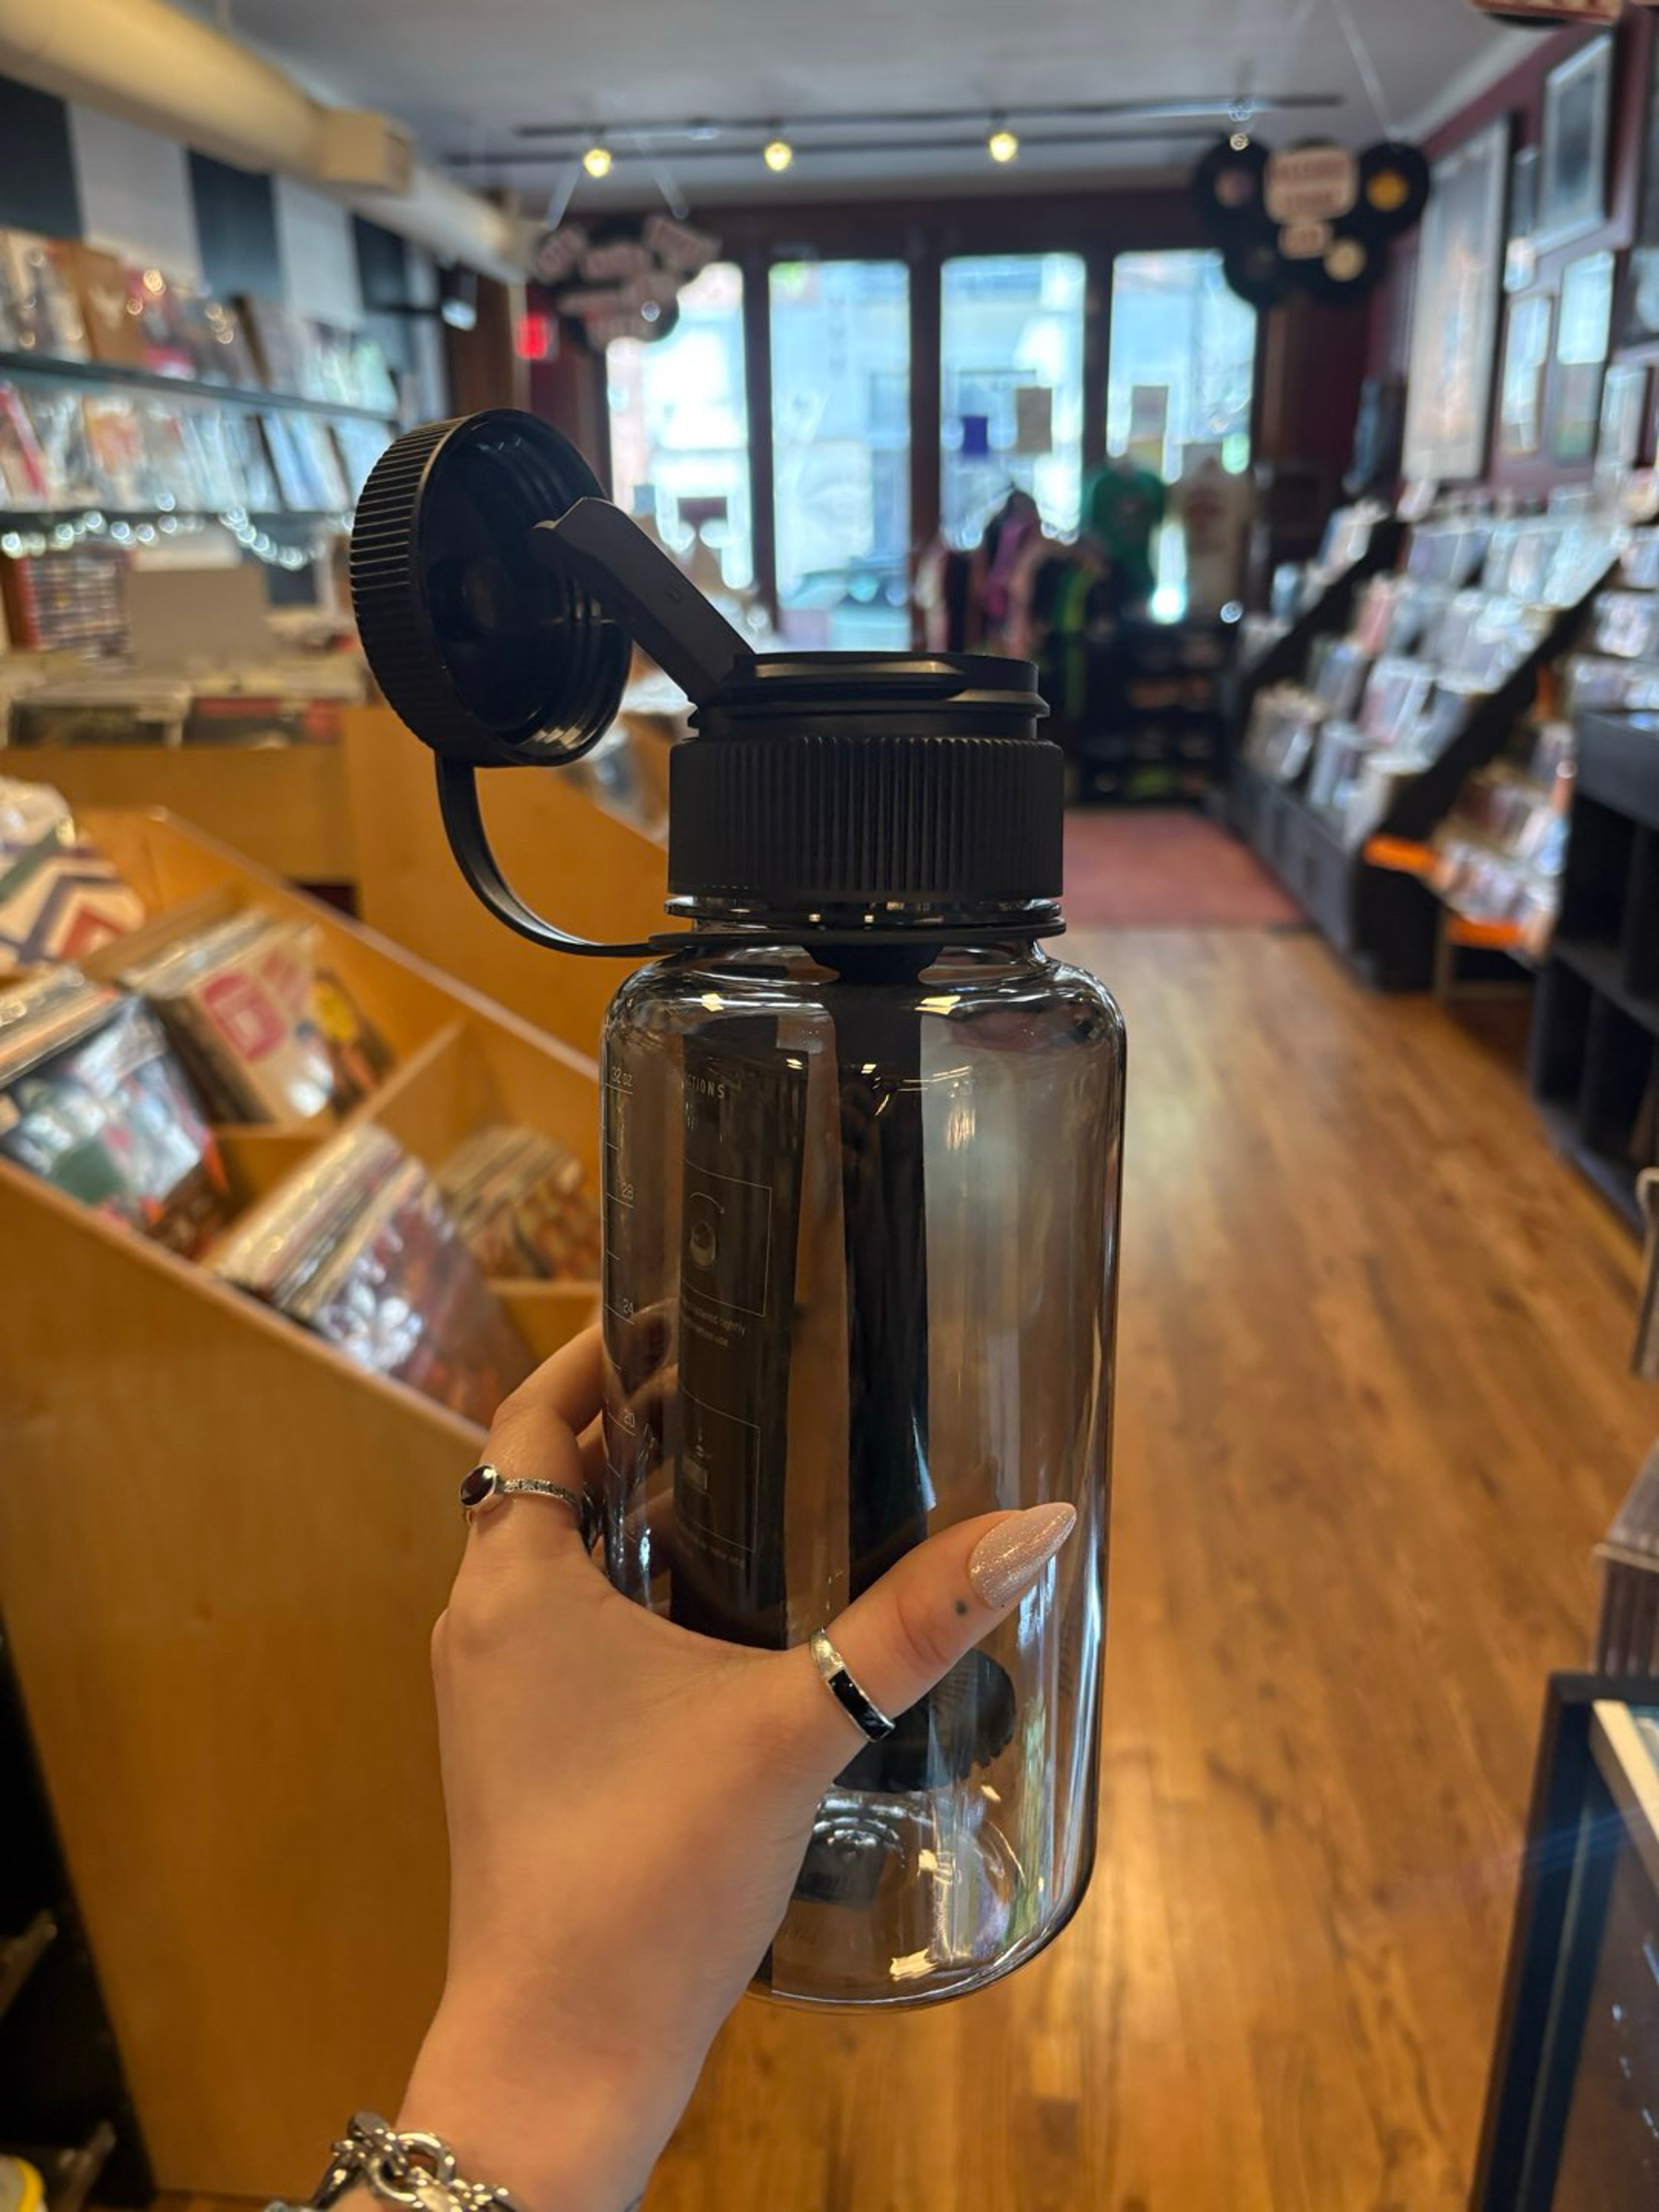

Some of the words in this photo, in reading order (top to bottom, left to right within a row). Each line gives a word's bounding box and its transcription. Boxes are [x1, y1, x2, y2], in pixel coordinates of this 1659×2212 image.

[611, 1066, 622, 1084] 32
[622, 1182, 634, 1201] 28
[623, 1297, 634, 1317] 24
